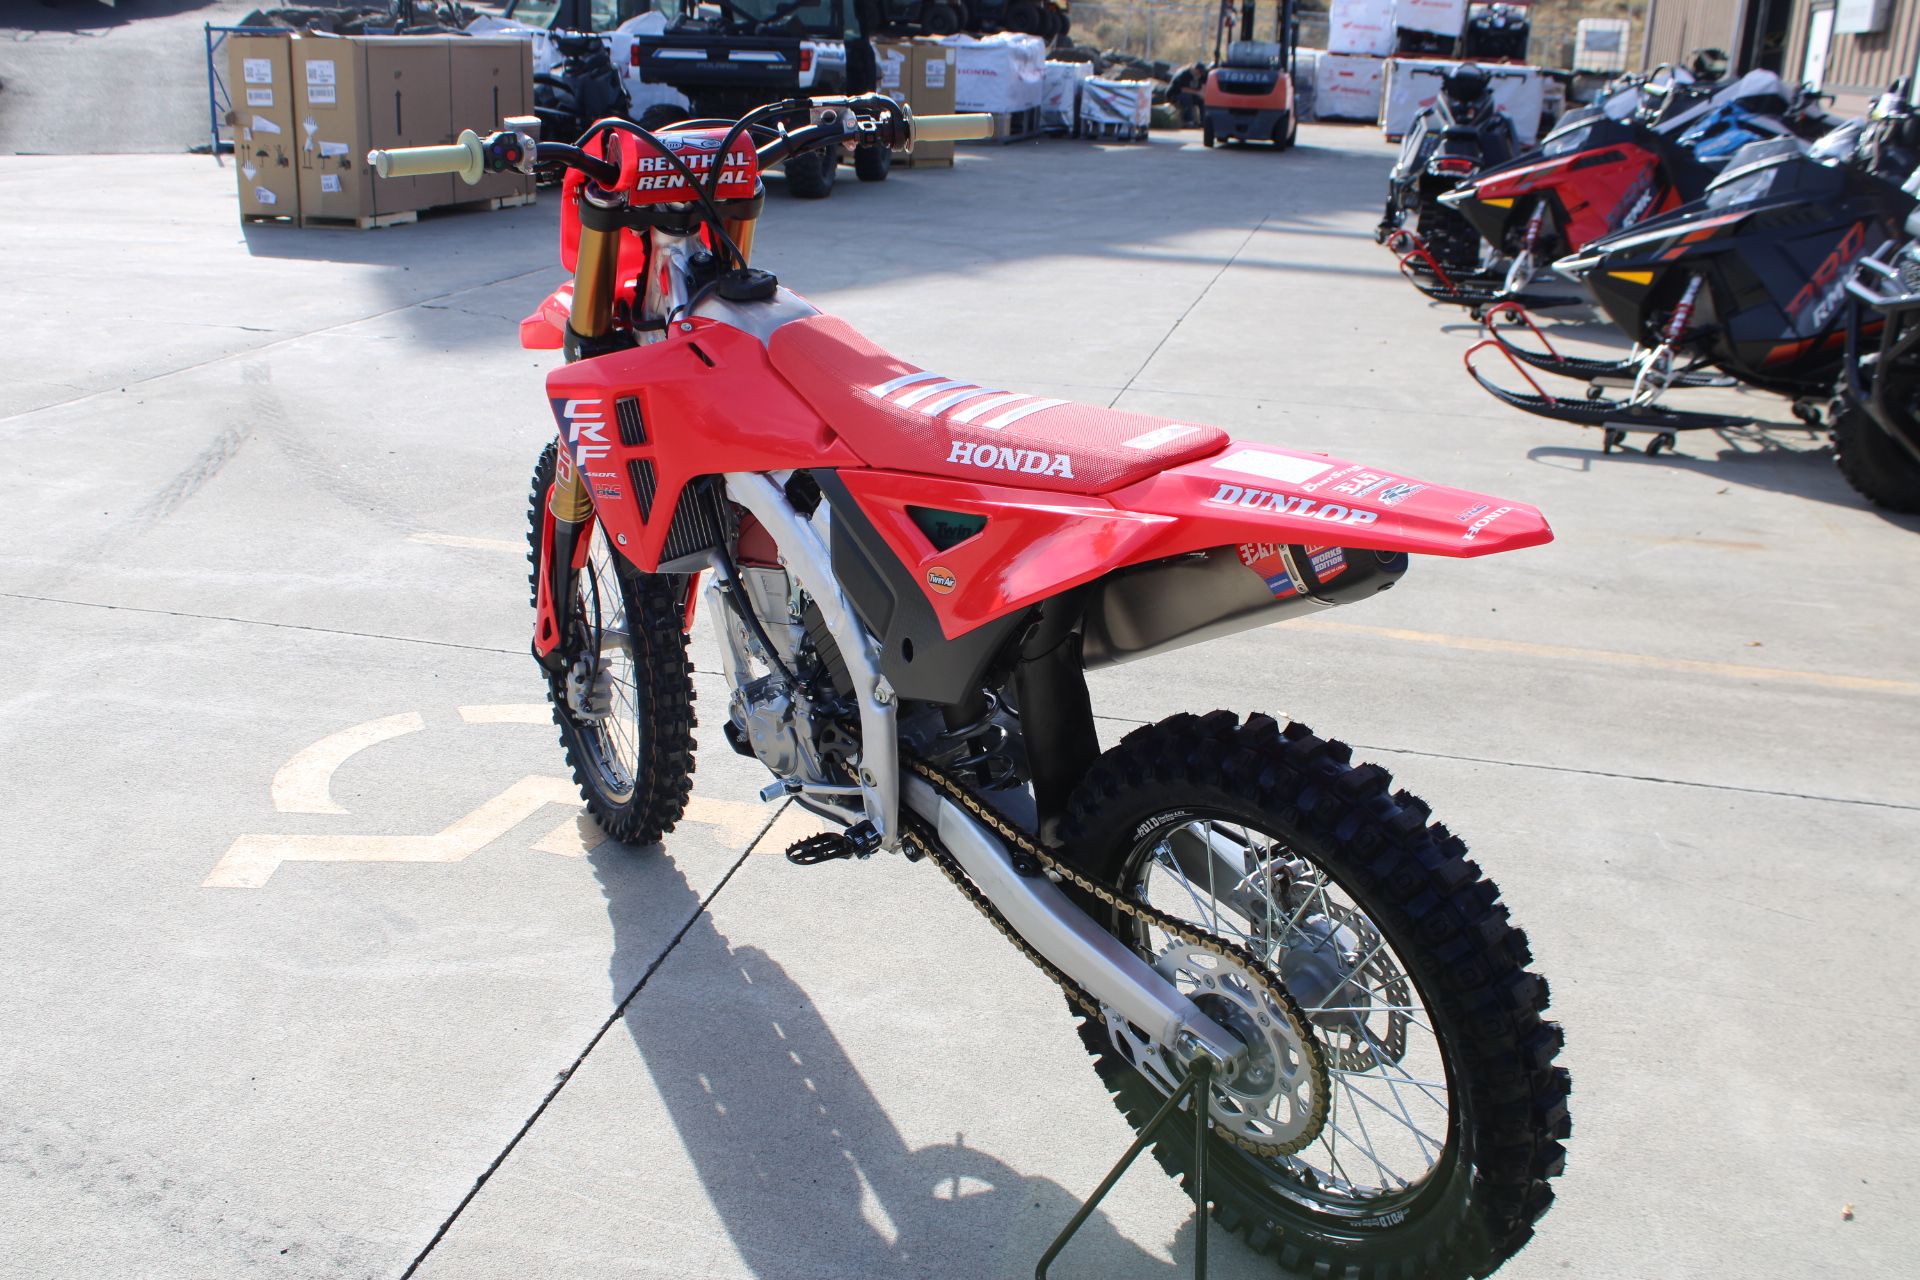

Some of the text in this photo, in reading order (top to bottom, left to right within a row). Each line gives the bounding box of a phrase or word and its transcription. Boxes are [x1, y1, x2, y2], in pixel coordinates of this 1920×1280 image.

[1224, 73, 1269, 81] TOYOTA
[947, 440, 1074, 479] HONDA
[1208, 483, 1378, 526] DUNLOP
[1461, 506, 1517, 541] HOND
[1311, 546, 1342, 566] WORKS
[1314, 555, 1343, 572] EDITION
